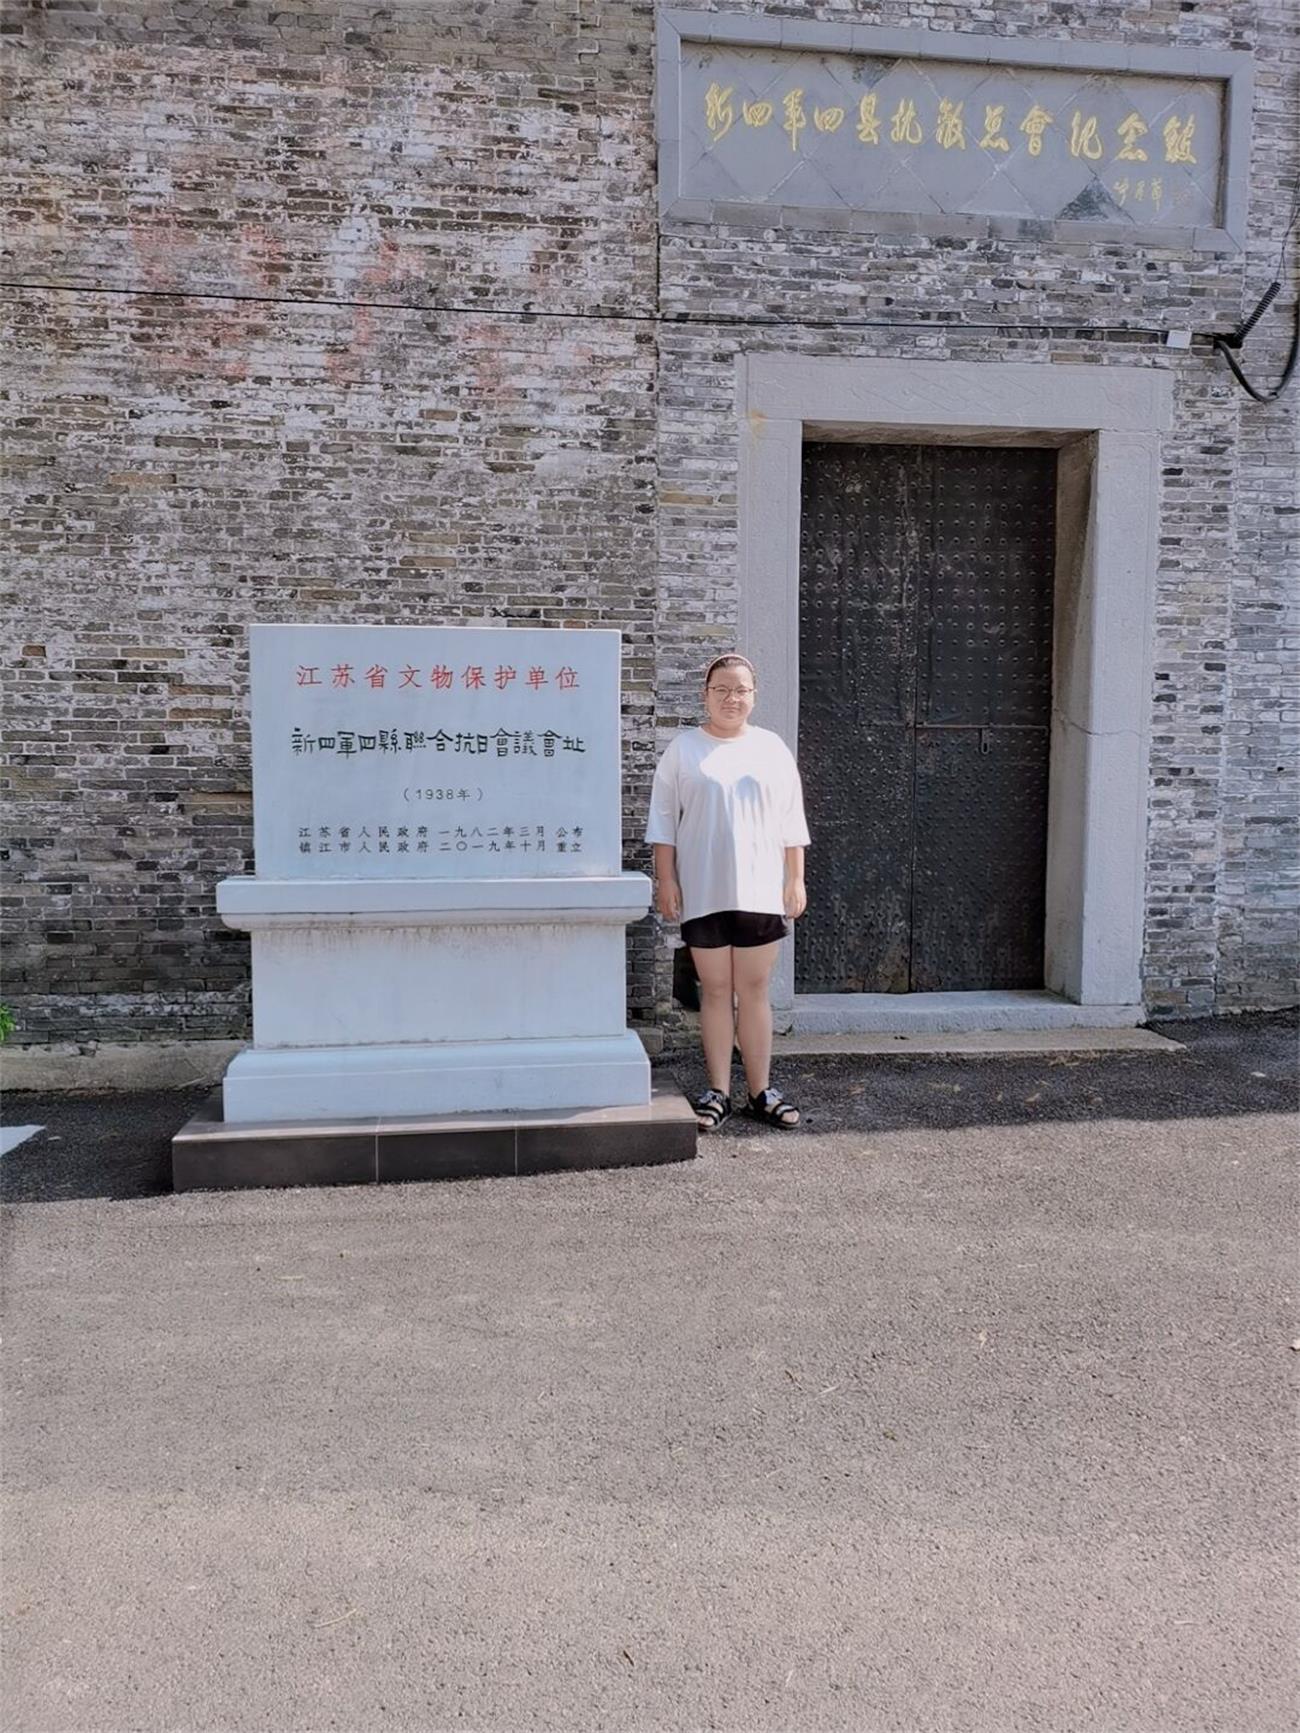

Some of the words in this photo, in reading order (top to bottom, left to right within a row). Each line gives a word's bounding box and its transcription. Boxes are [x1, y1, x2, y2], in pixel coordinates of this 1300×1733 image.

[296, 664, 580, 690] 江苏省文物保护单位
